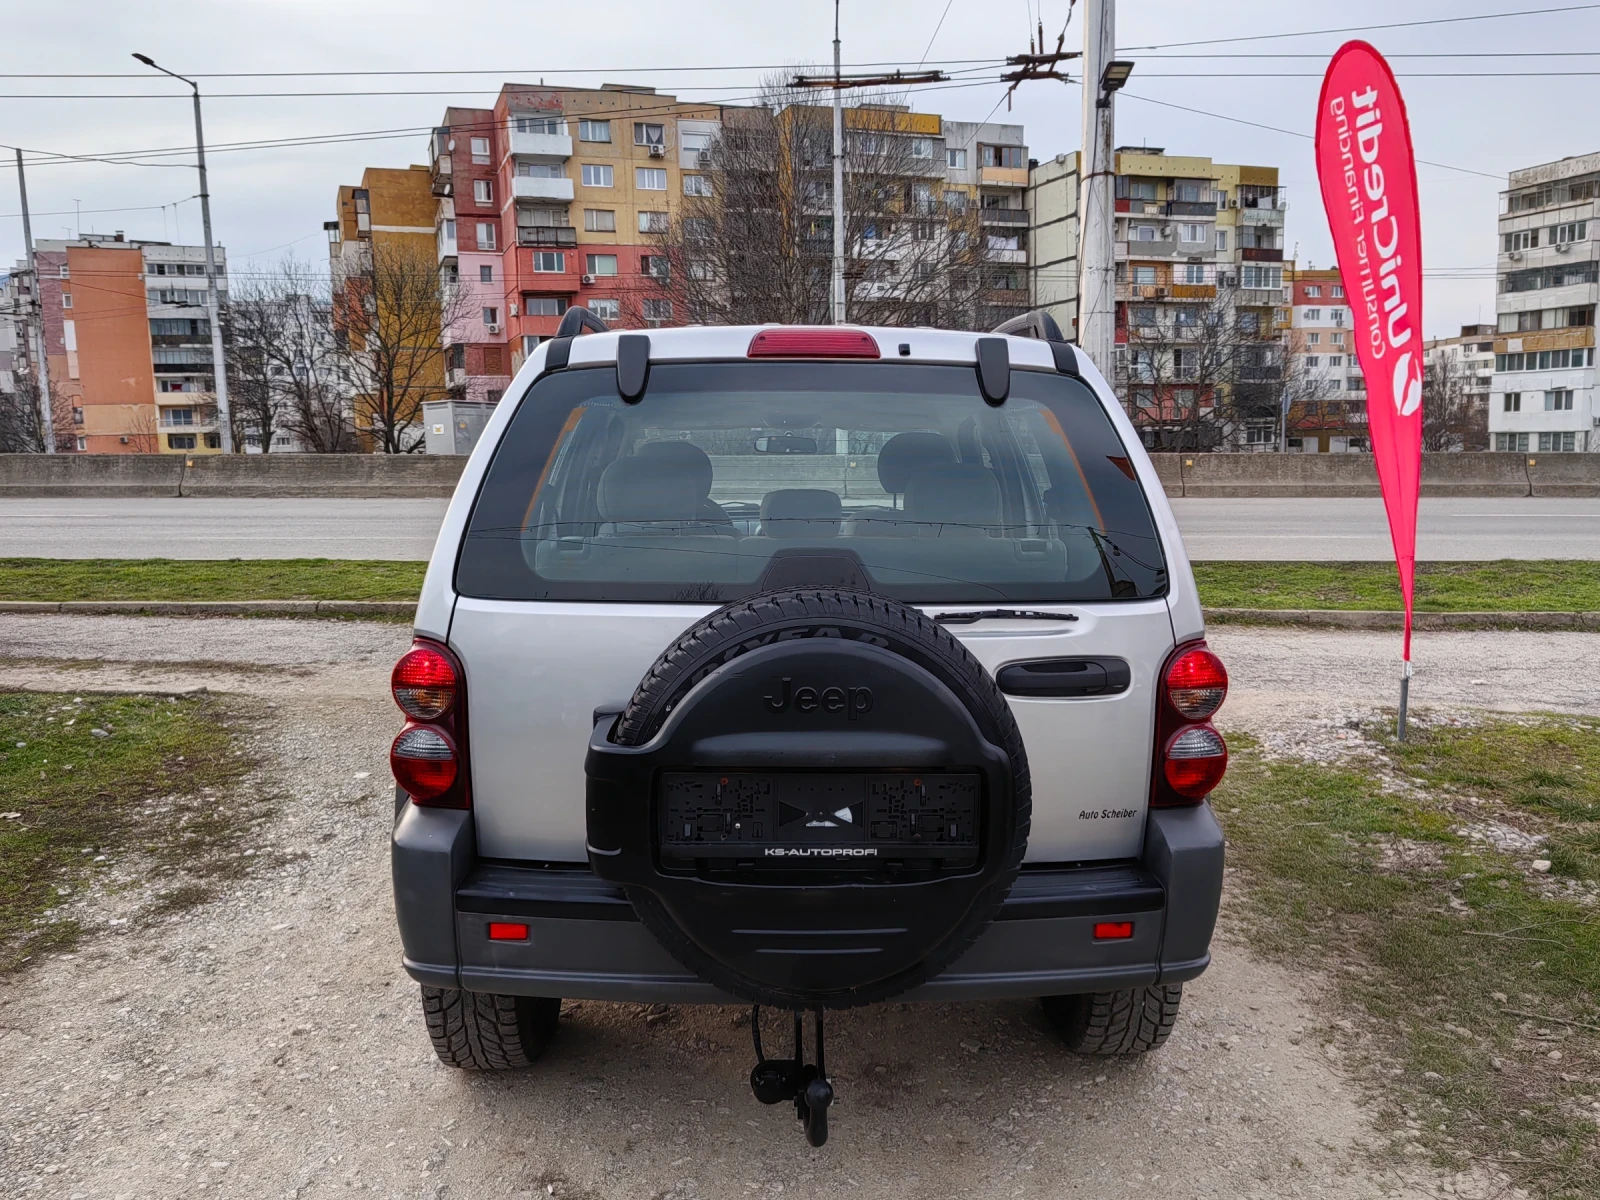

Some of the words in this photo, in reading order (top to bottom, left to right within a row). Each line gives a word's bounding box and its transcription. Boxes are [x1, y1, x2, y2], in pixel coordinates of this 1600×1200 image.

[763, 677, 874, 720] Jeep
[1078, 810, 1099, 820] Auto
[1100, 808, 1137, 819] Scheiber
[764, 848, 878, 856] KS-AUTOPROFI
